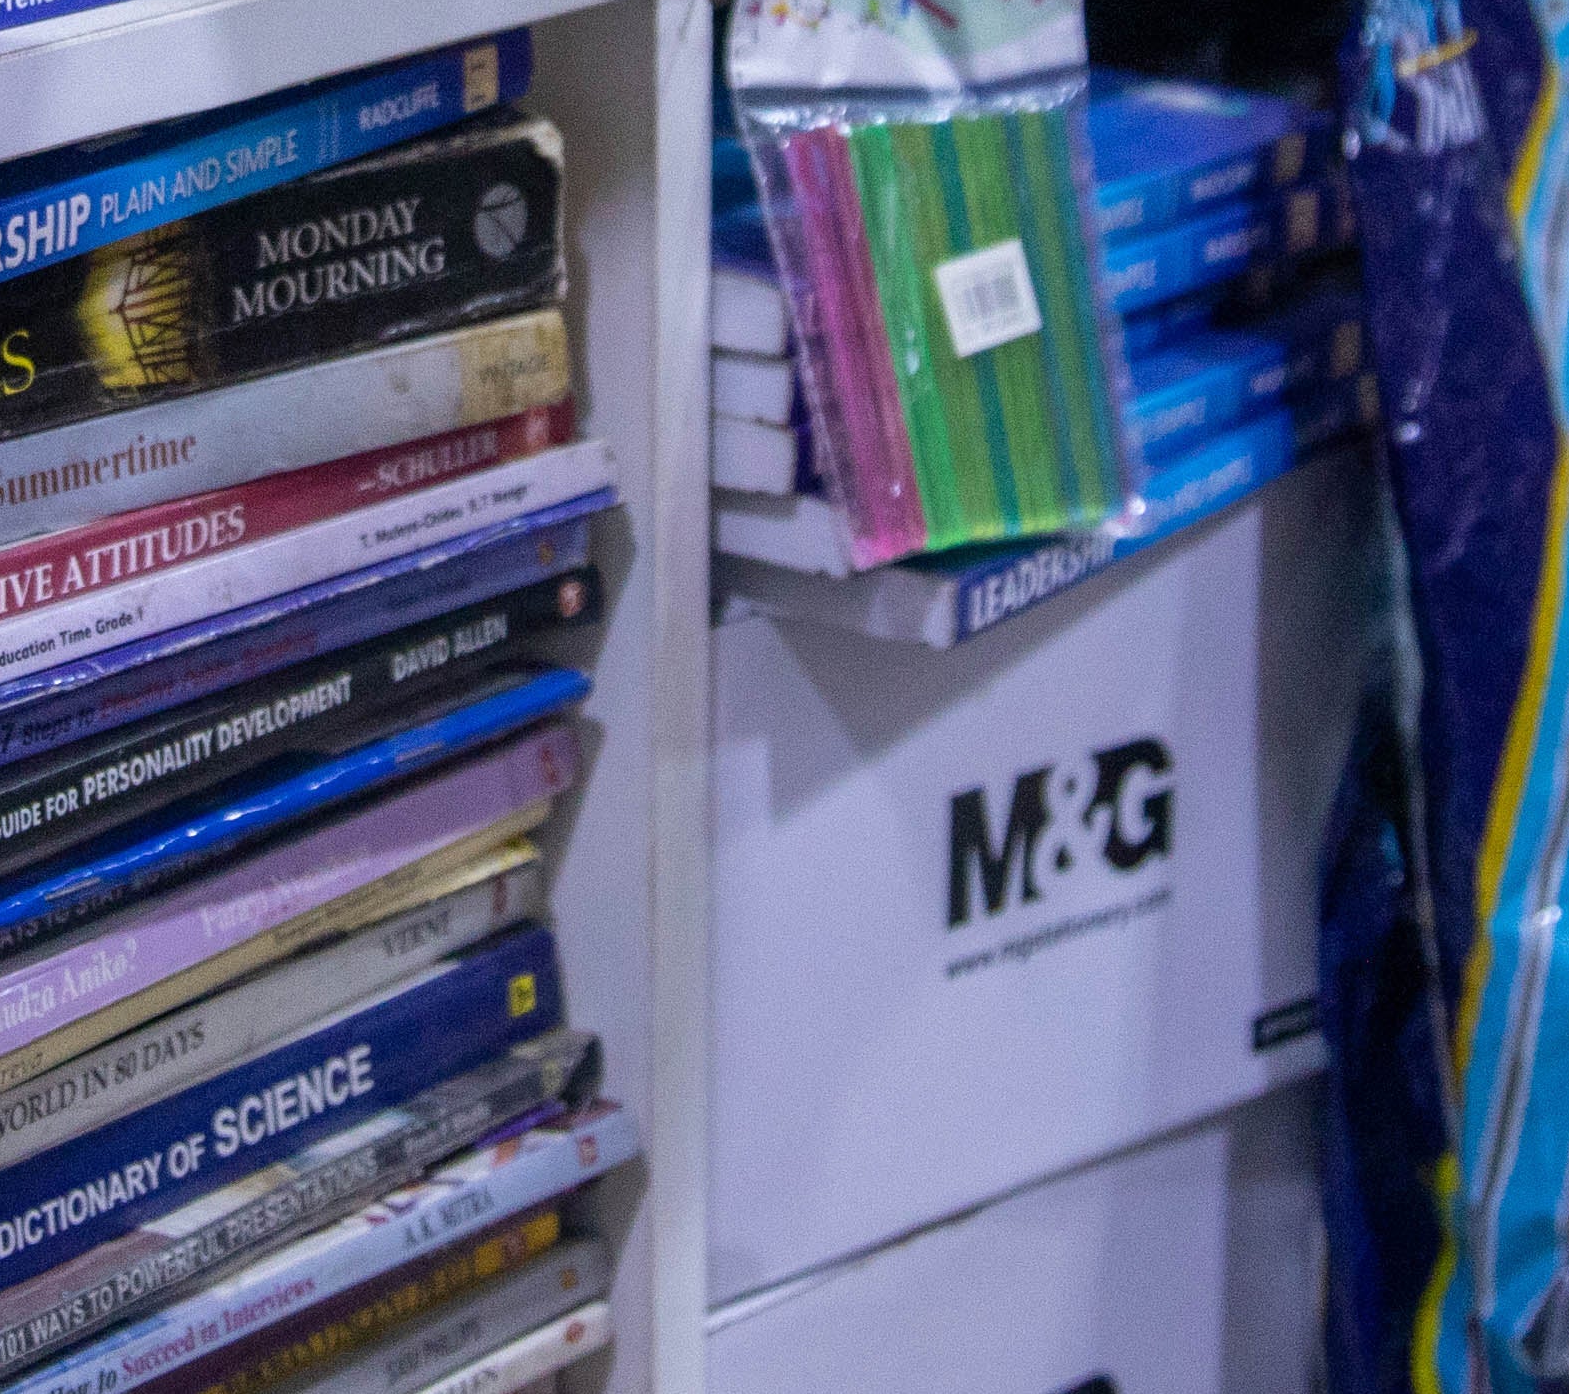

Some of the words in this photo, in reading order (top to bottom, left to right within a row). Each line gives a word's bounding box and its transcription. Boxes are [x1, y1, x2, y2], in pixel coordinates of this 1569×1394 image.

[100, 181, 167, 228] PLAIN
[170, 164, 221, 204] AND
[225, 129, 298, 183] SIMPLE
[258, 197, 422, 268] MONDAY
[232, 242, 447, 324] MOURNING
[59, 627, 92, 648] Time
[96, 615, 134, 637] Grade
[44, 789, 79, 823] FOR
[83, 731, 213, 808] PERSONALITY
[216, 674, 354, 759] DEVELOPMENT
[392, 636, 450, 686] DAVID
[453, 614, 507, 660] ALLEN
[946, 737, 1174, 930] M&G
[168, 1134, 207, 1179] OF
[213, 1045, 376, 1159] SCIENCE
